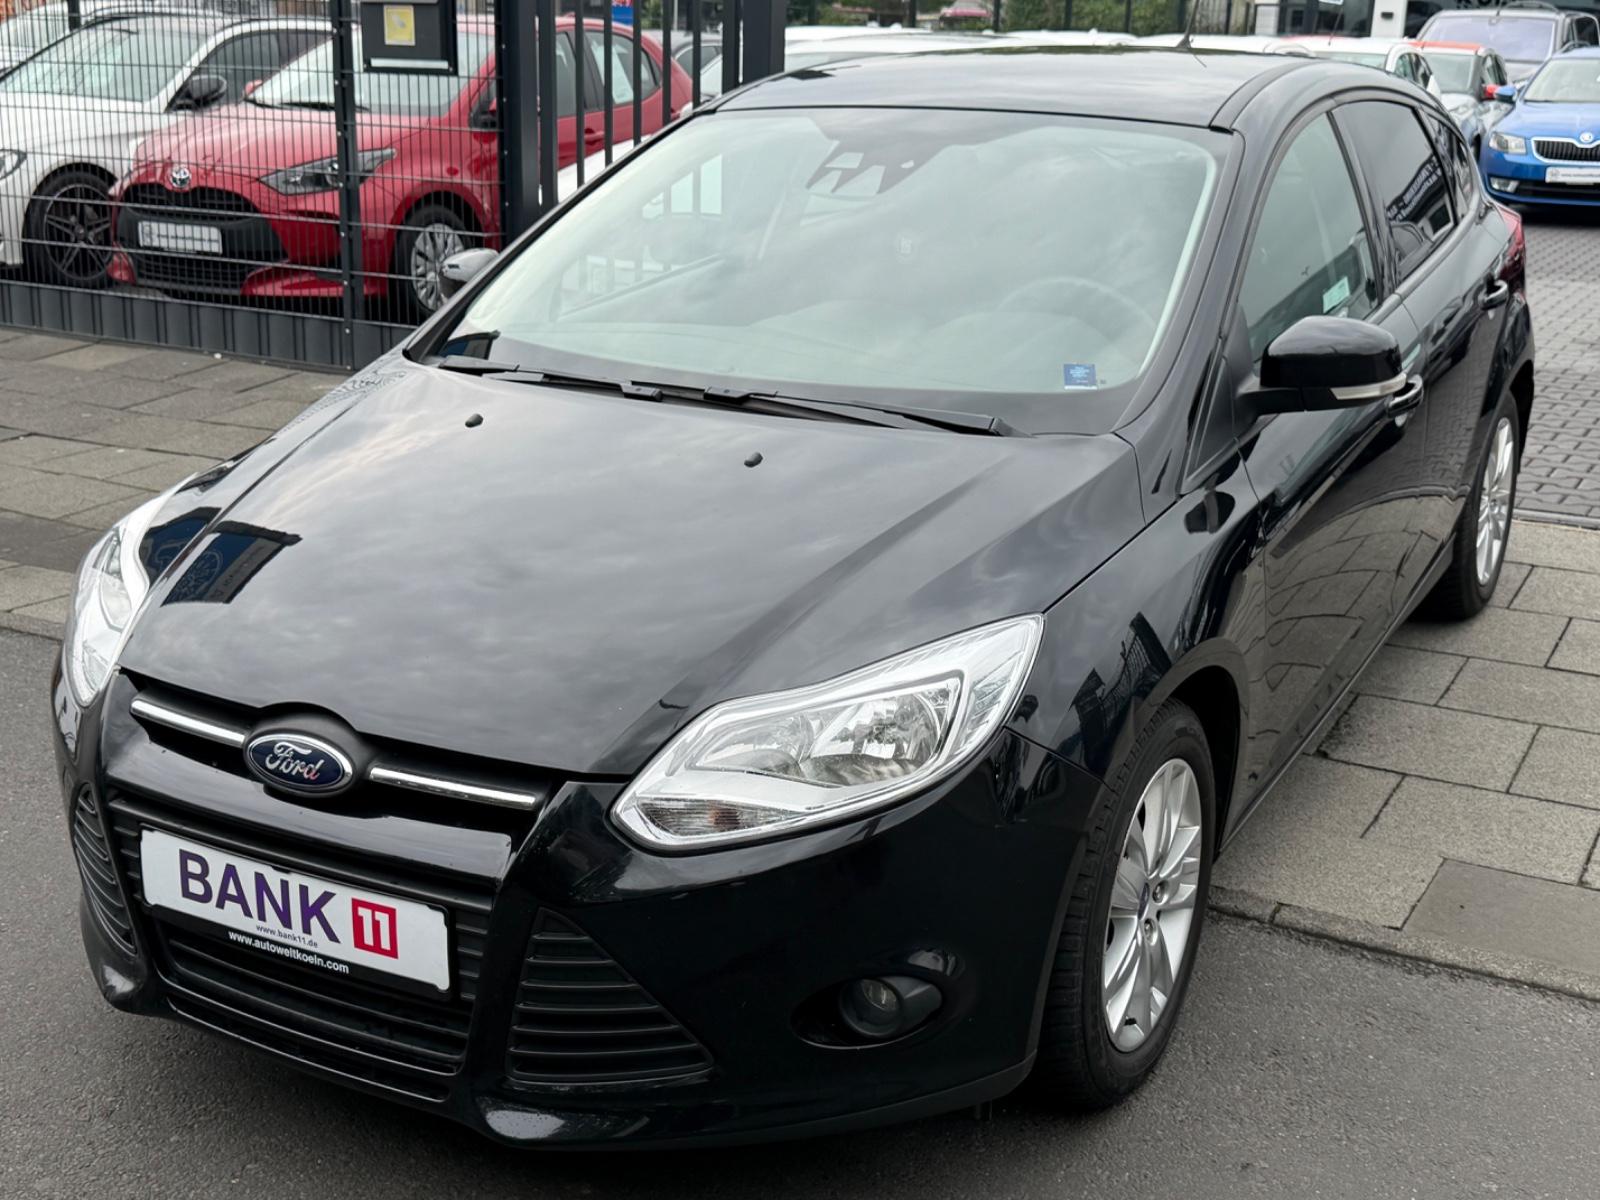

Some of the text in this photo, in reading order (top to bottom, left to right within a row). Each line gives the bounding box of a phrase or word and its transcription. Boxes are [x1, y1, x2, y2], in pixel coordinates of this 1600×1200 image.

[265, 741, 325, 781] Ford
[179, 848, 393, 952] BANK 11
[228, 931, 349, 974] www.autoweltkoeln.com
[256, 925, 318, 948] www.bank11.de
